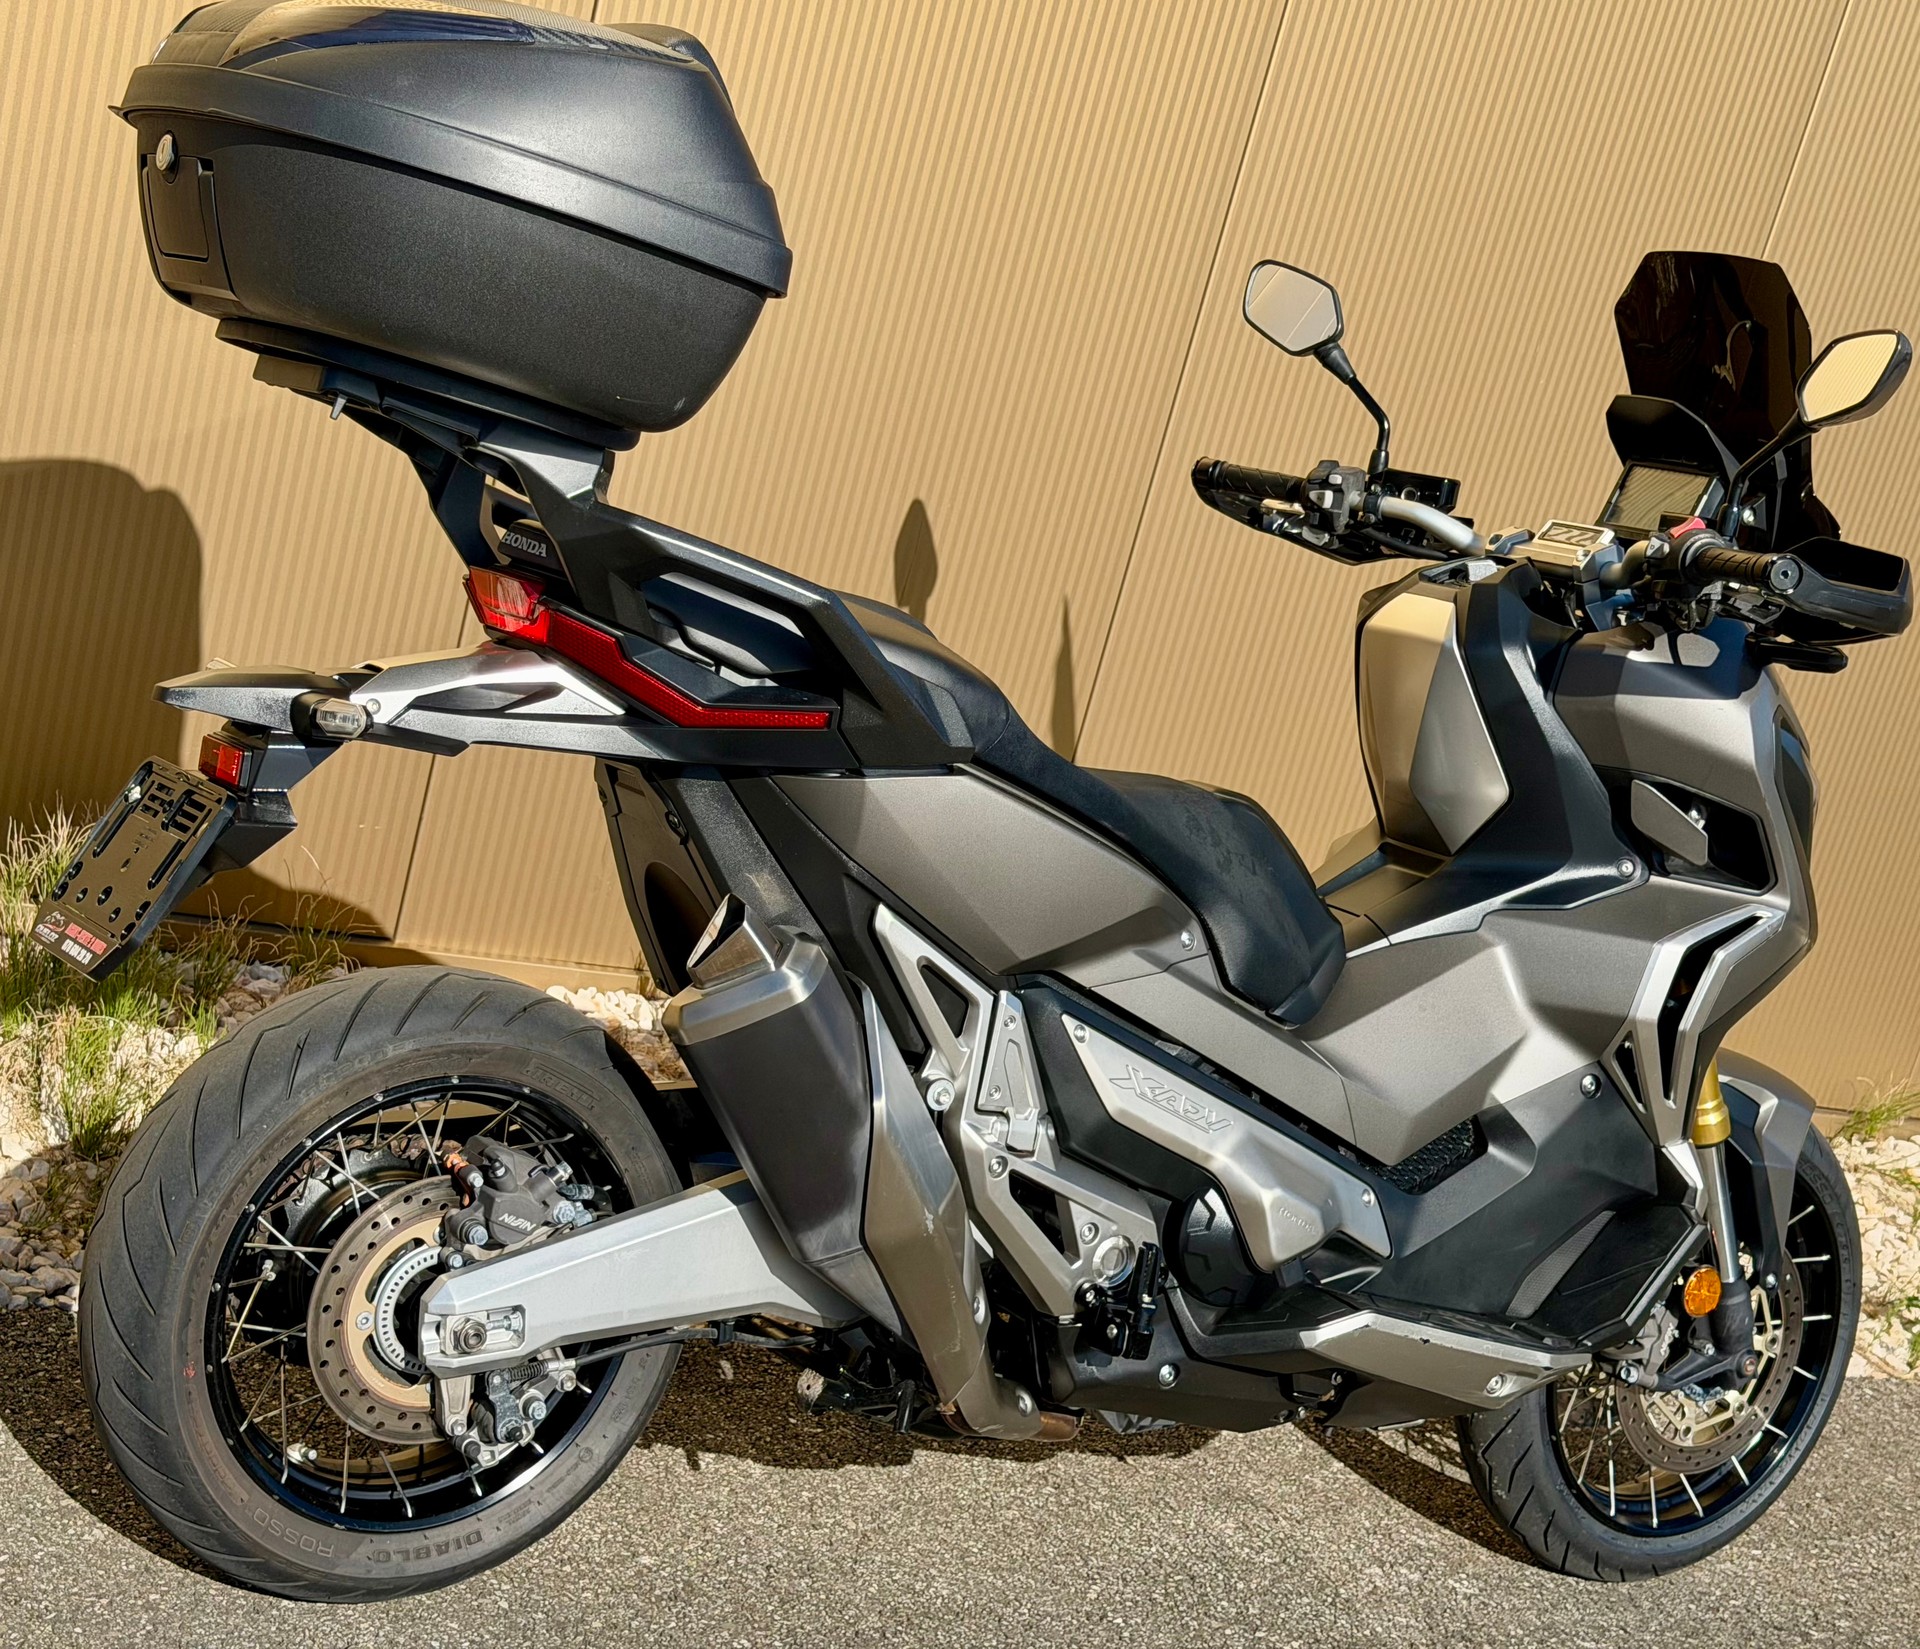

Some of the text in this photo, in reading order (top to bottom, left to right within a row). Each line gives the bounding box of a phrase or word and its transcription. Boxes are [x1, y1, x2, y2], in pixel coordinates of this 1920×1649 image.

[501, 532, 547, 558] HONDA
[253, 1507, 483, 1564] DIABLO ROSSO
